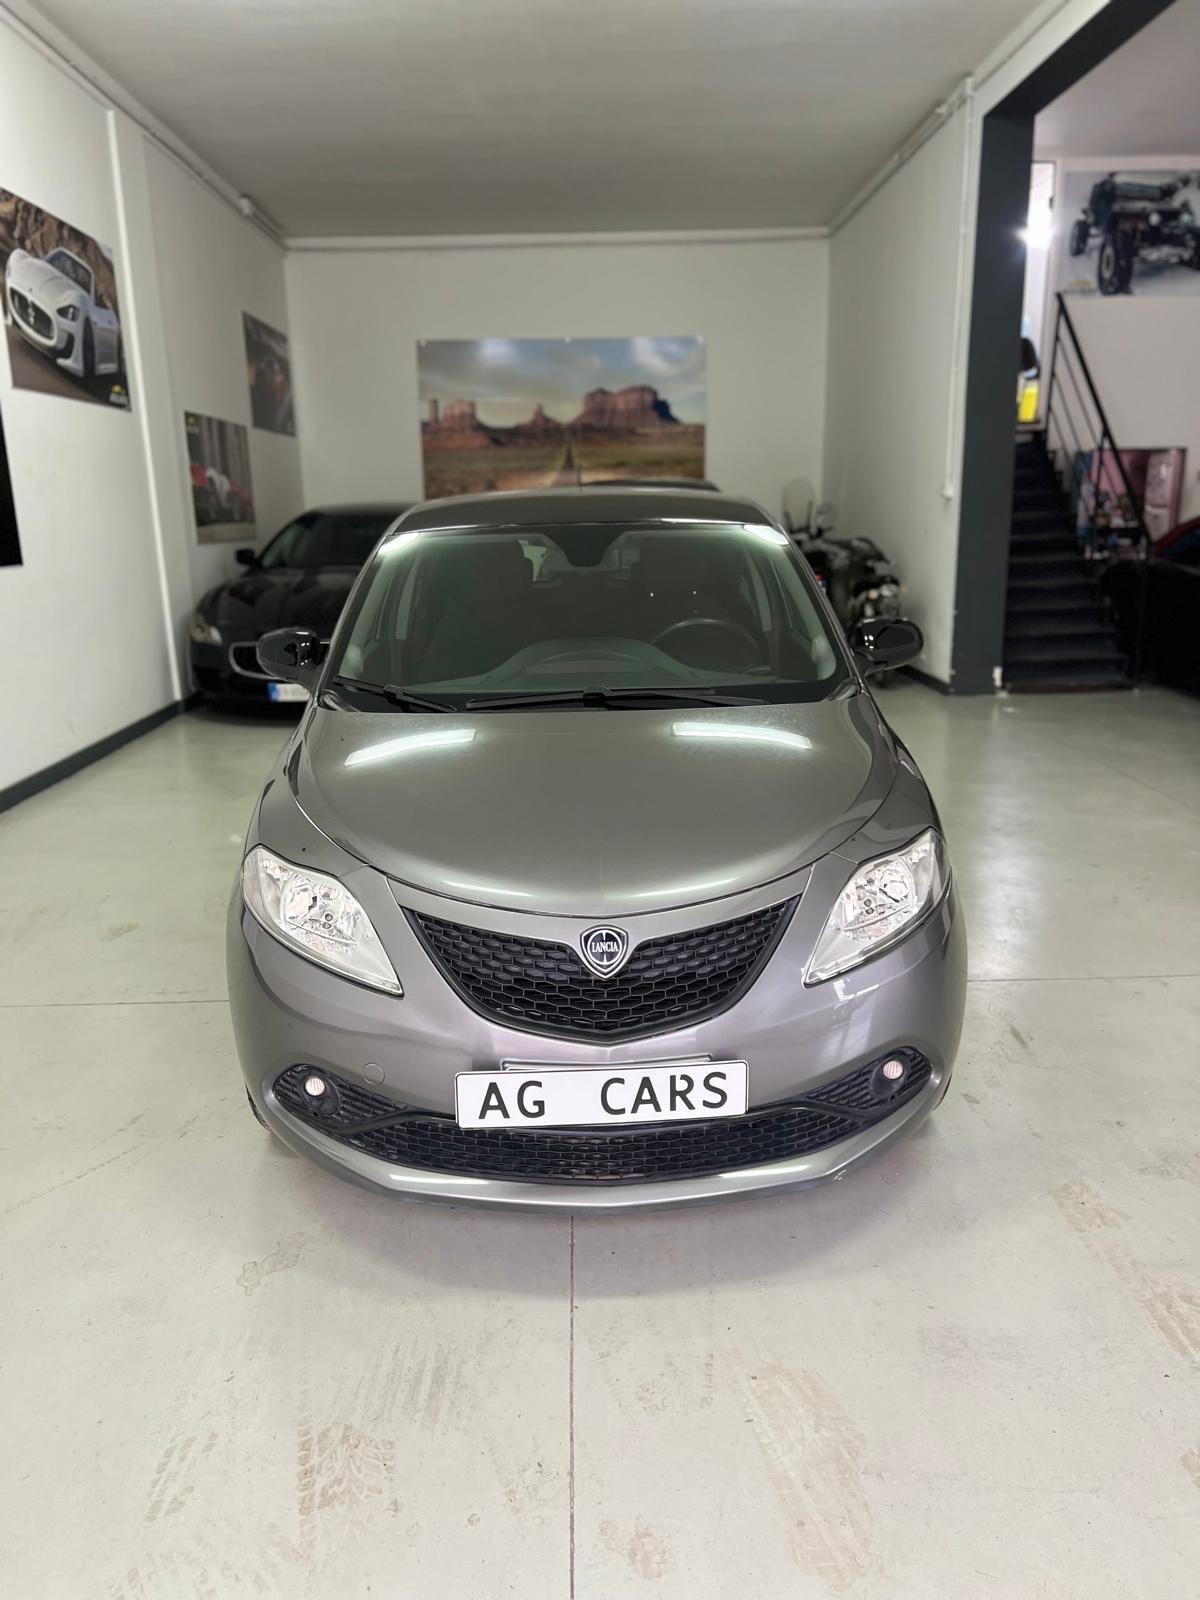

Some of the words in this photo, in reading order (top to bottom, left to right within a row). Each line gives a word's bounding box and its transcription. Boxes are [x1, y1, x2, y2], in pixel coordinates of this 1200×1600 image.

[591, 941, 619, 953] LANCIA
[478, 1080, 546, 1120] AG
[600, 1071, 728, 1116] CARS
